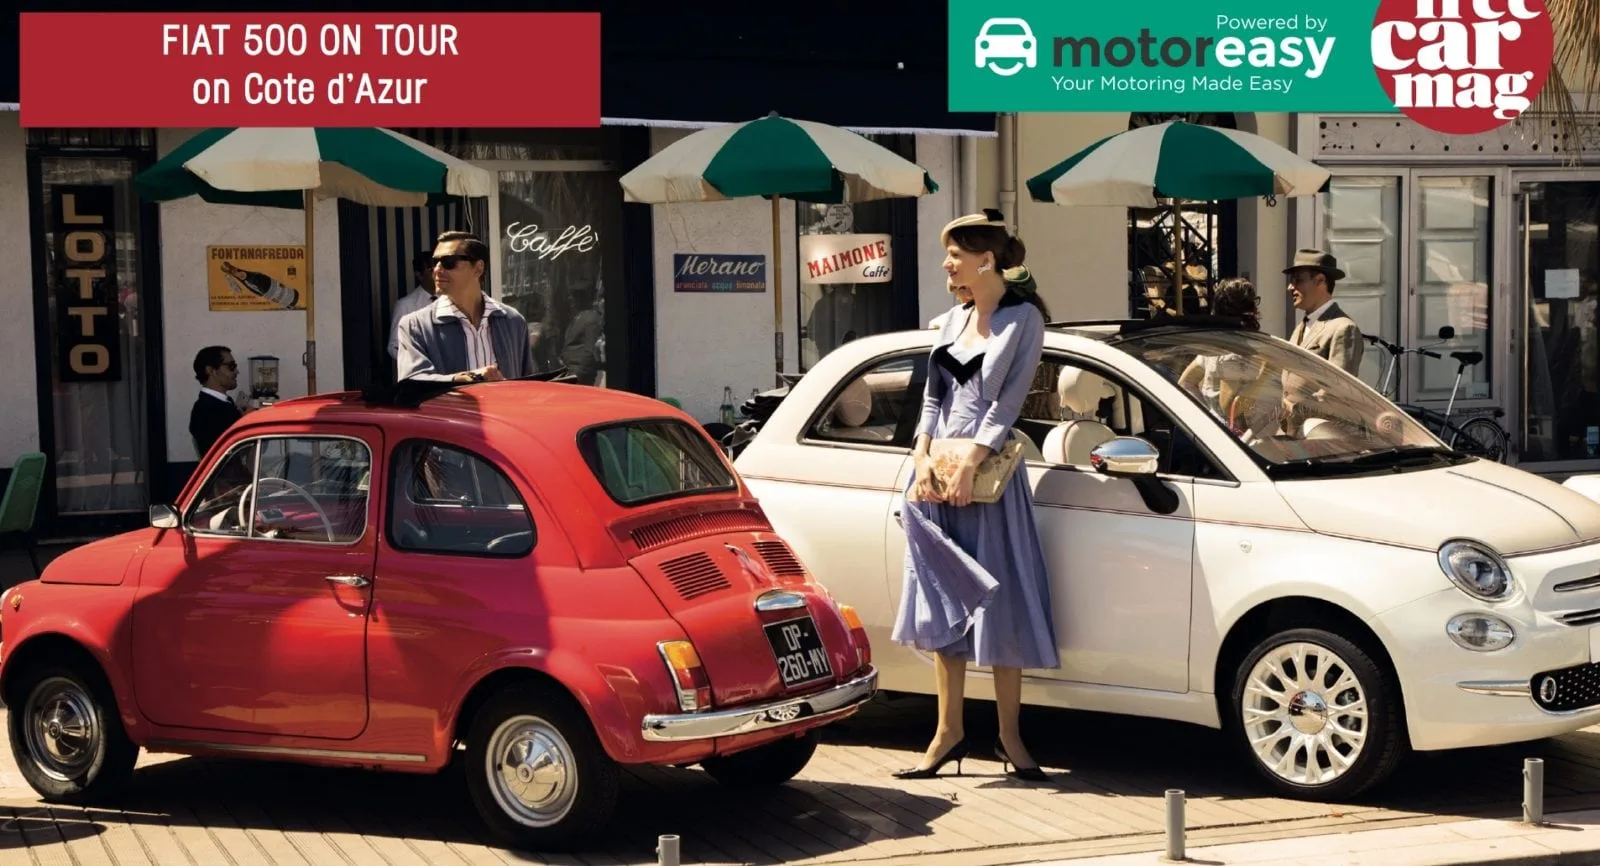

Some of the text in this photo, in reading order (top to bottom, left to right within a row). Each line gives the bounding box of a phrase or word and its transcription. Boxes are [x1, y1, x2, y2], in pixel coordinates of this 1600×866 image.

[211, 247, 304, 260] FONTANAFREDDA
[675, 255, 765, 278] Merano
[807, 240, 887, 279] MAIMONE
[62, 193, 110, 374] LOTTO
[778, 647, 829, 682] 260-MY
